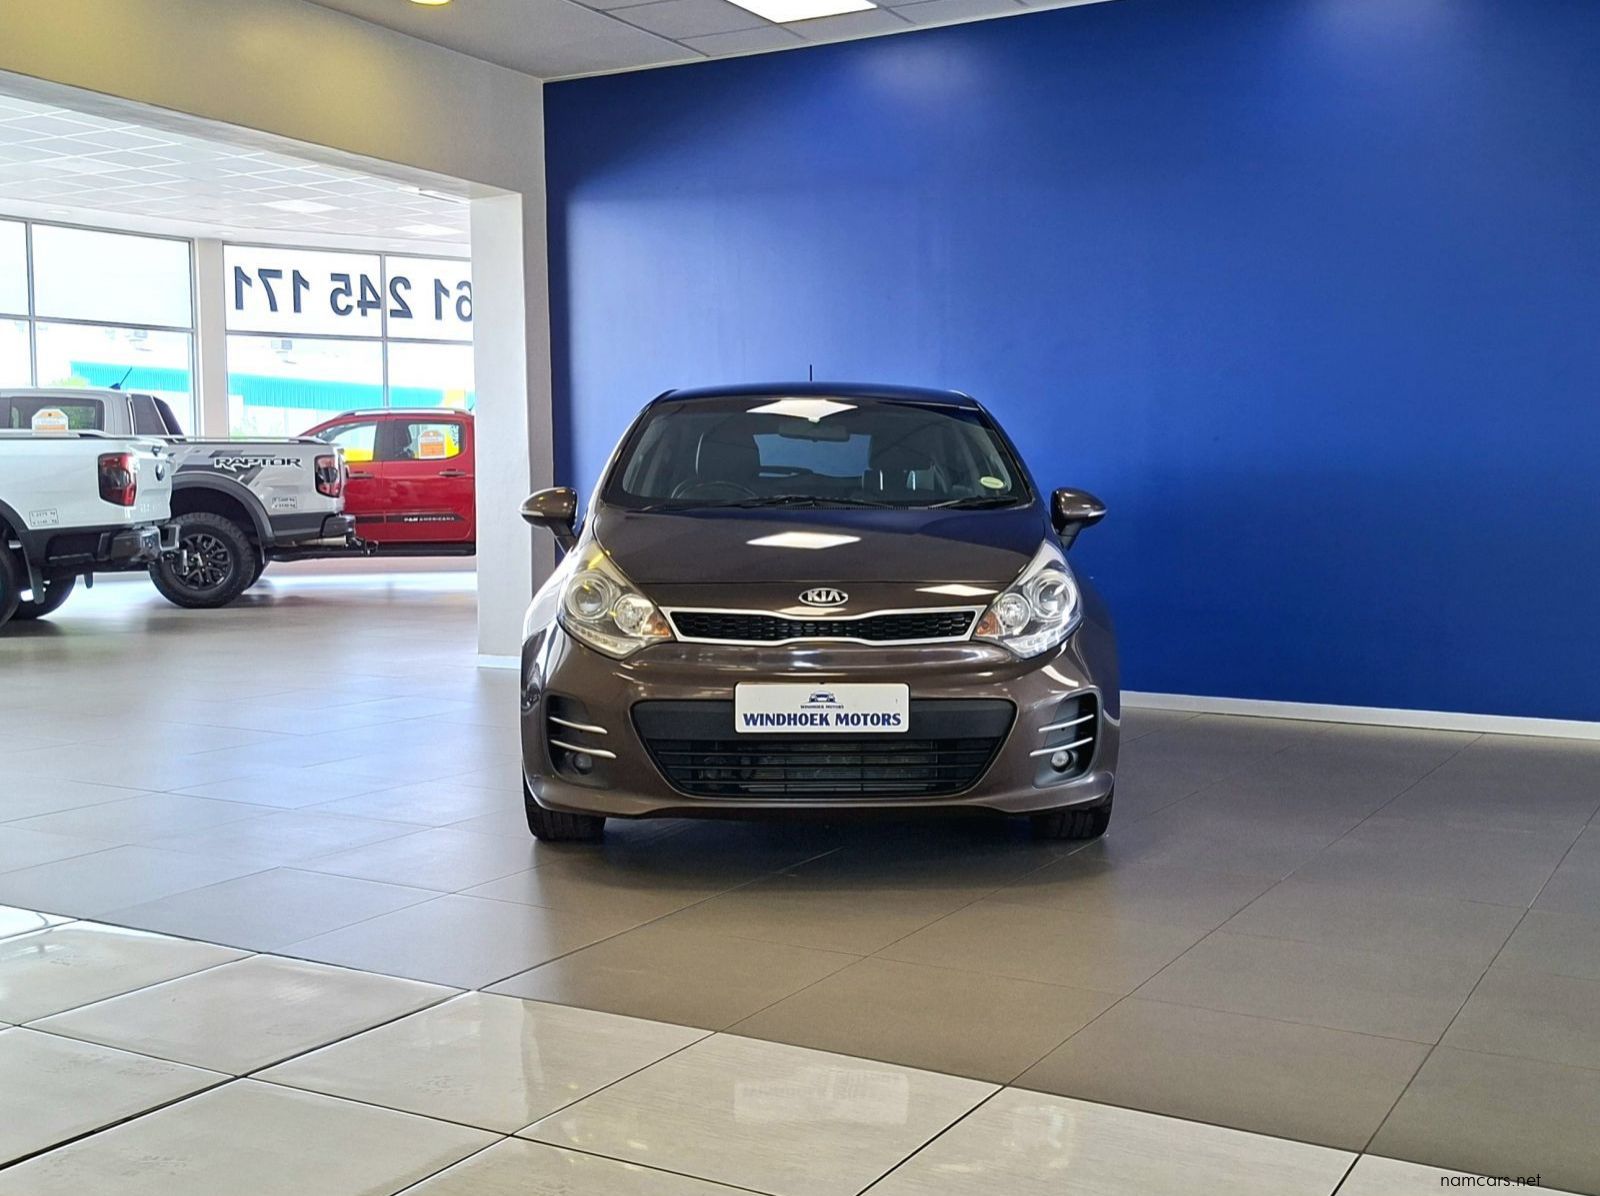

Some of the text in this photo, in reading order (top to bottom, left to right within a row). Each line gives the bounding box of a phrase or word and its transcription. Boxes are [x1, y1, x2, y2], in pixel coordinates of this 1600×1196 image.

[214, 457, 303, 472] RAPTOR
[807, 588, 841, 602] KIA
[743, 713, 901, 726] WINDHOEK MOTORS
